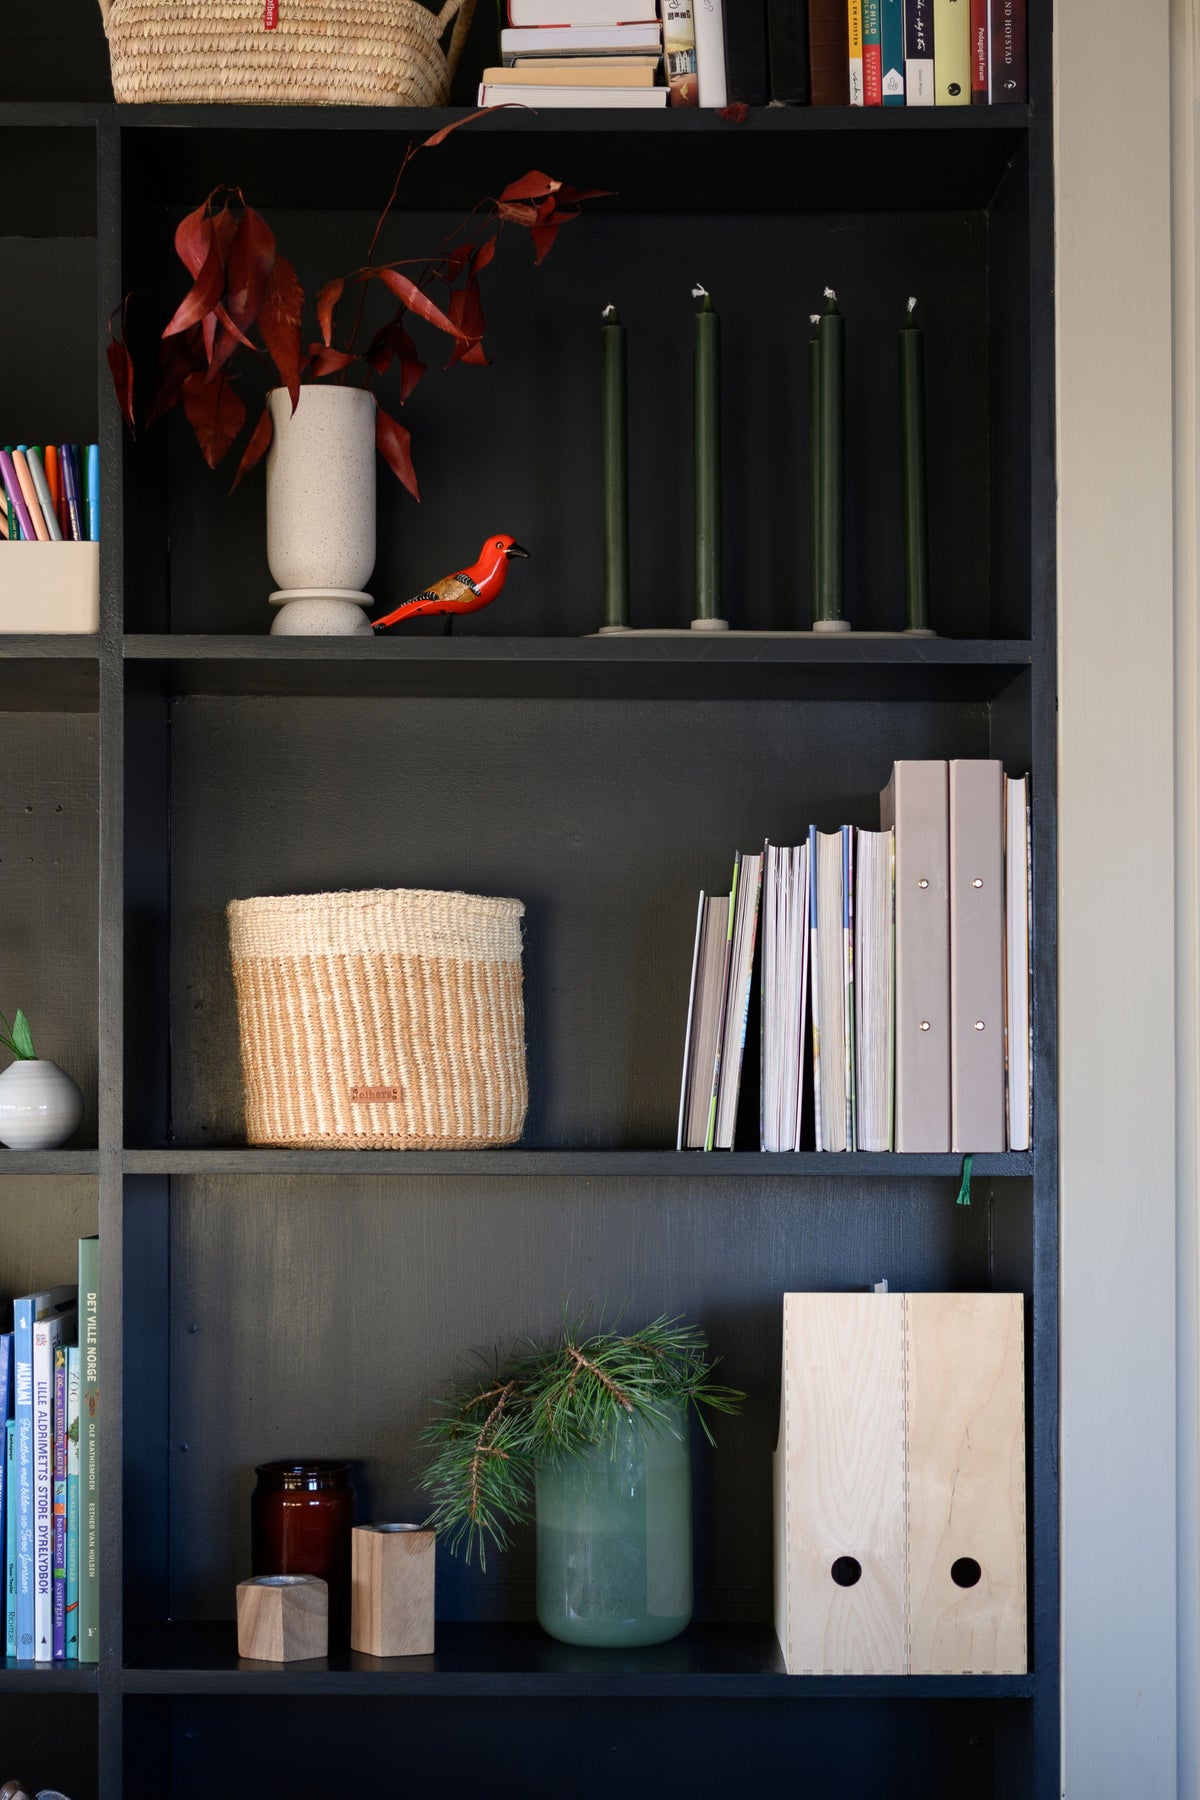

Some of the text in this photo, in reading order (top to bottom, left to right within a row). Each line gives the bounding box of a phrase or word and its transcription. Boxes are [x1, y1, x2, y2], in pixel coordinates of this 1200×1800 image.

[852, 6, 858, 15] EN
[869, 3, 877, 34] CHILD
[977, 27, 986, 81] Pedagogisk Forum
[1004, 19, 1012, 64] HOFSTAD
[86, 1292, 97, 1382] DET VILLE NORGE
[16, 1362, 32, 1405] MUMMI
[69, 1372, 79, 1402] ZOG
[19, 1467, 30, 1487] med
[88, 1423, 96, 1491] OLE MATHISMOEN
[37, 1381, 49, 1595] LILLE ALDRIMETTS STORE DYRELYDBOK
[69, 1484, 77, 1531] DONALDSON
[20, 1515, 28, 1527] av
[20, 1529, 32, 1552] Tove
[88, 1502, 96, 1578] ESTHER VAN HULSEN
[18, 1553, 32, 1594] Jansson
[54, 1582, 63, 1627] SCHEFFLER
